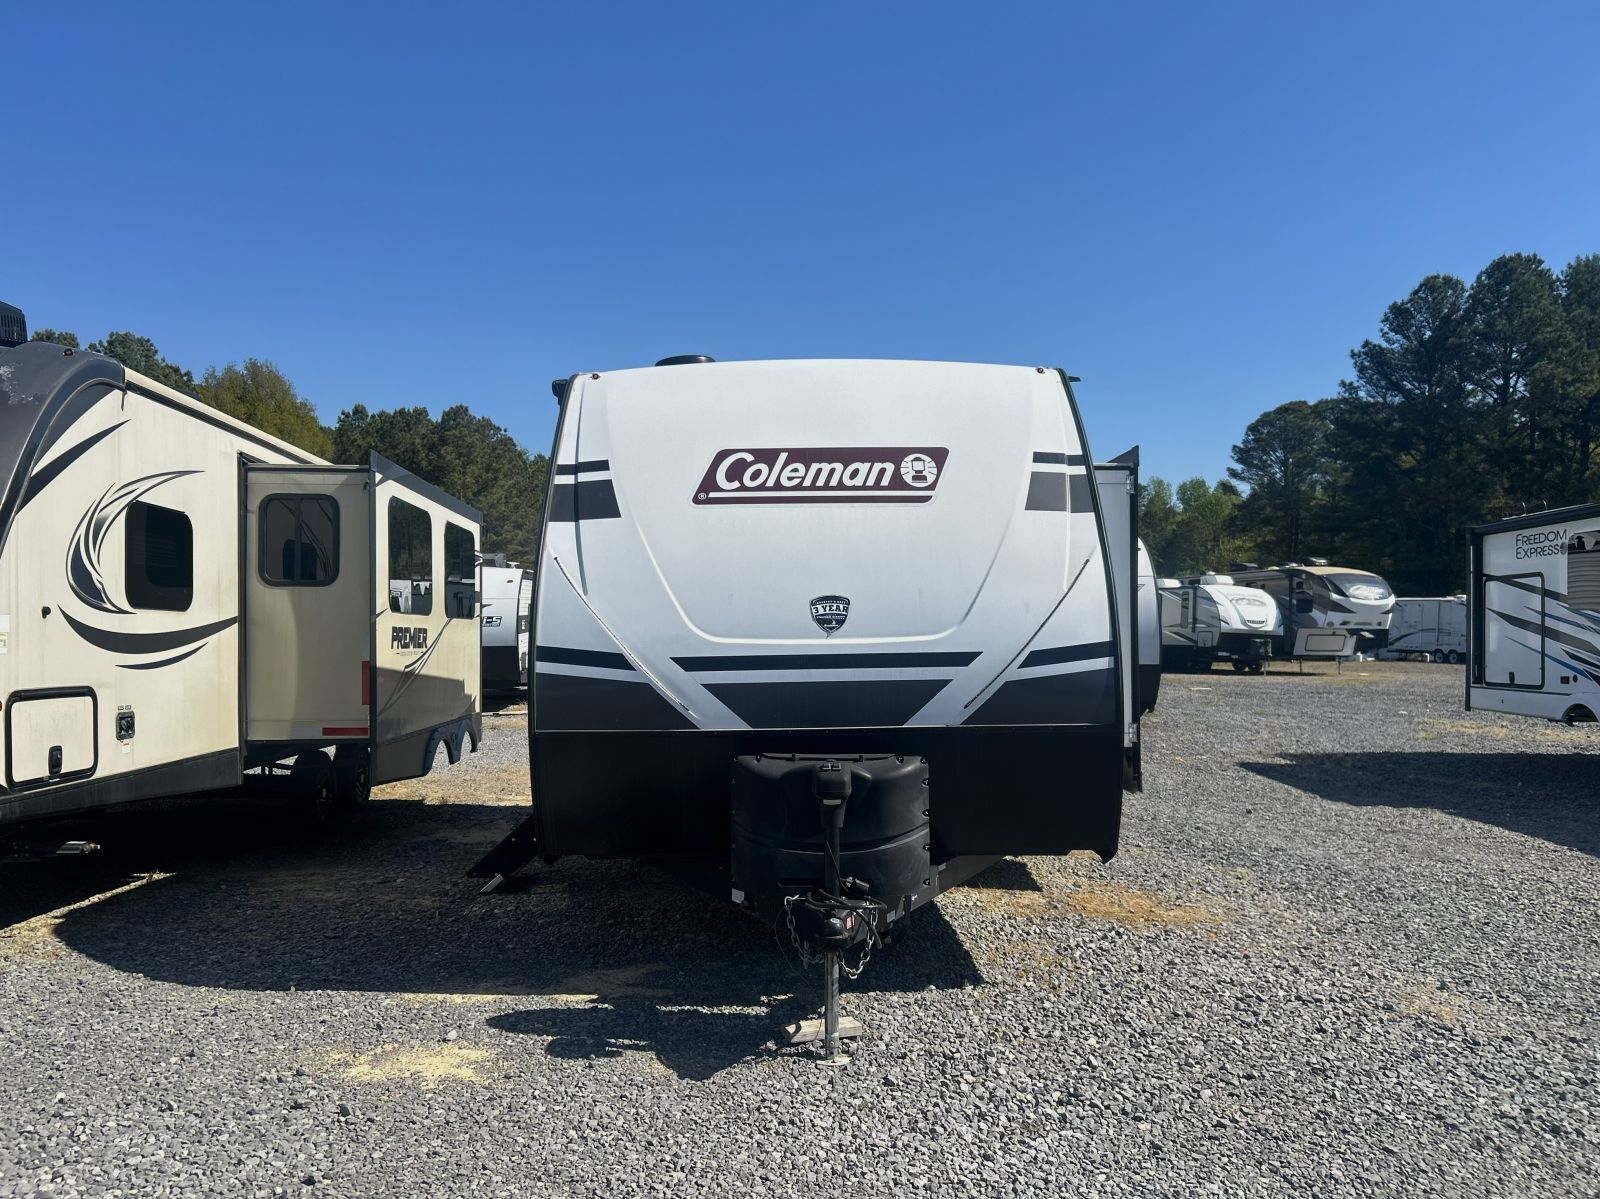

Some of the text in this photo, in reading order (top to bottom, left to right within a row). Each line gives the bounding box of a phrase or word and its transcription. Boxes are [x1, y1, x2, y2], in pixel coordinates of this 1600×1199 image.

[716, 452, 895, 490] Coleman
[1516, 529, 1567, 546] FREEDOM
[1516, 544, 1559, 559] EXPRESS
[813, 604, 849, 614] 3 YEAR
[391, 626, 427, 649] PREMIER
